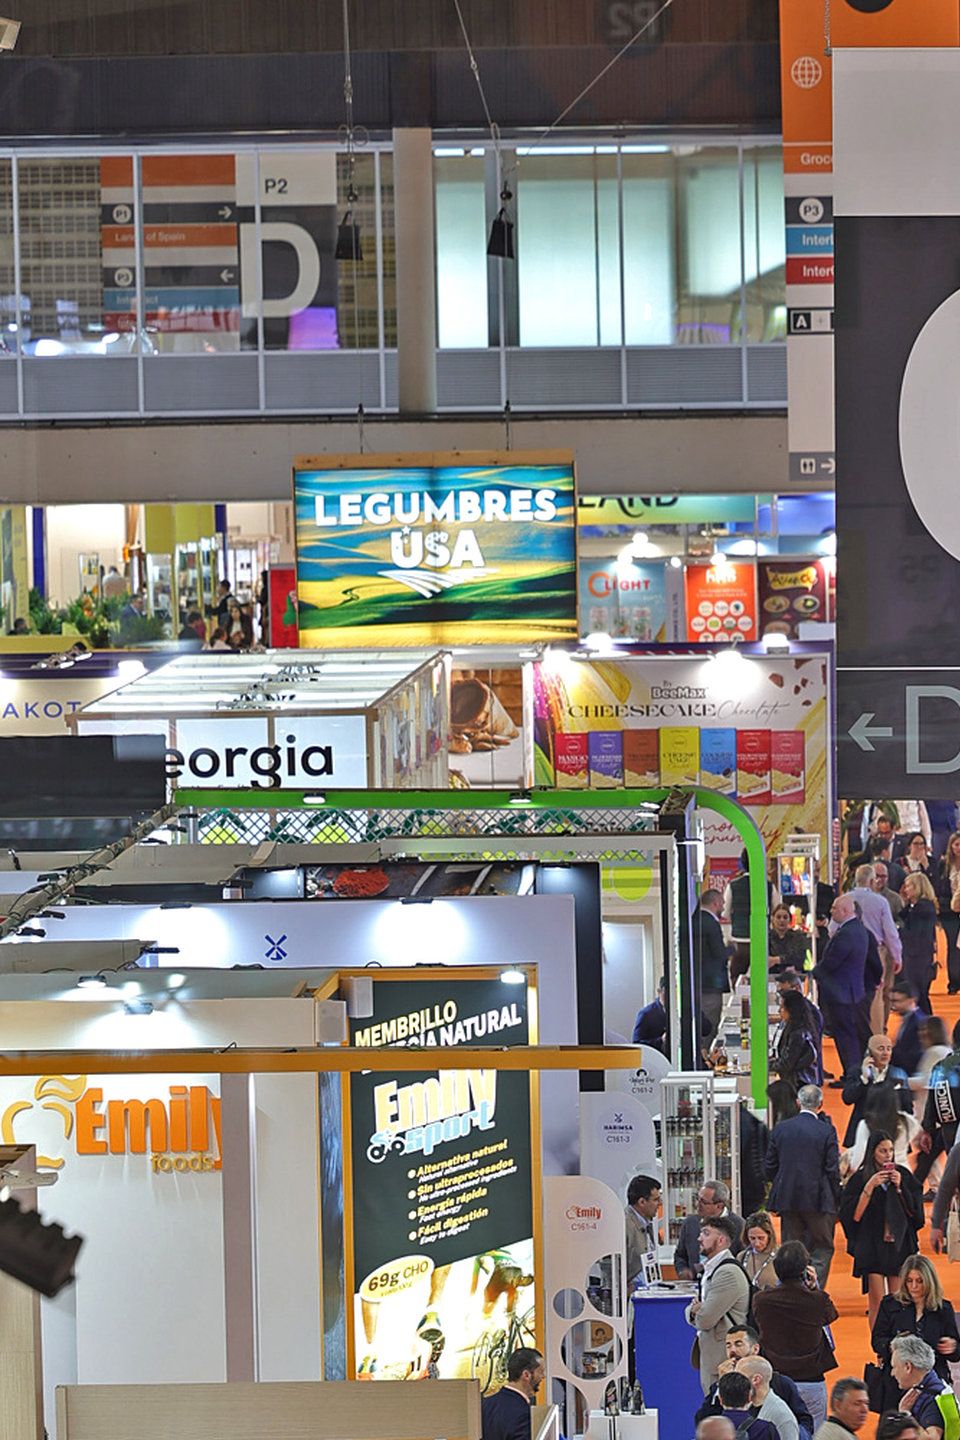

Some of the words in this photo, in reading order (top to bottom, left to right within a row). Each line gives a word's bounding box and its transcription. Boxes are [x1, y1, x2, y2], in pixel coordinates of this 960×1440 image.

[801, 152, 832, 165] Groc
[264, 178, 288, 194] P2
[803, 205, 819, 216] P3
[240, 222, 320, 318] D
[795, 313, 807, 328] A
[314, 489, 558, 527] LEGUMBRES
[390, 530, 486, 569] USA
[652, 686, 706, 699] BeeMax
[568, 703, 718, 718] CHEESECAKE
[165, 734, 334, 788] eorgia
[355, 1000, 457, 1047] MEMBRILLO
[440, 1003, 522, 1047] NATURAL
[404, 1101, 496, 1156] sport
[151, 1153, 214, 1174] foods
[416, 1152, 471, 1177] Alternativa
[471, 1138, 508, 1159] natural
[417, 1183, 434, 1196] Sin
[434, 1158, 514, 1190] ultraprocesados
[442, 1208, 489, 1229] digestión
[576, 1206, 601, 1220] Emily
[368, 1270, 401, 1292] 69g
[402, 1260, 429, 1280] CHO
